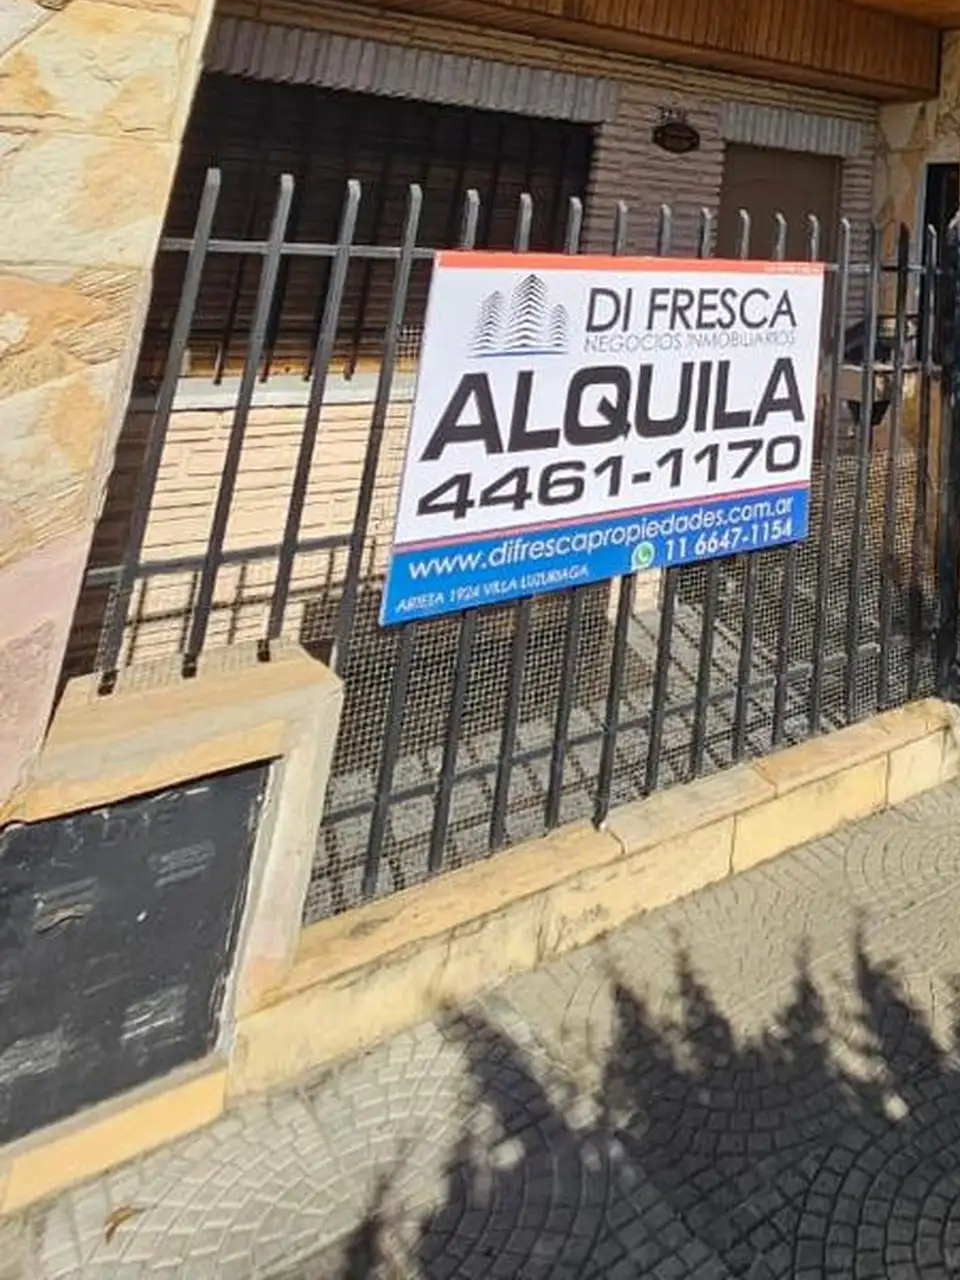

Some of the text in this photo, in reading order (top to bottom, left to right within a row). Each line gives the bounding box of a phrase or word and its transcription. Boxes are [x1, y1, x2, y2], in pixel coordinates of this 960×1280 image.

[586, 287, 798, 332] DI FRESCA
[583, 331, 683, 354] NEGOCIOS
[420, 357, 806, 462] ALQUILA
[416, 435, 802, 520] 4461-1170
[408, 495, 795, 581] www.difrescapropiedades.com.ar
[665, 517, 794, 562] 11 6647-1154
